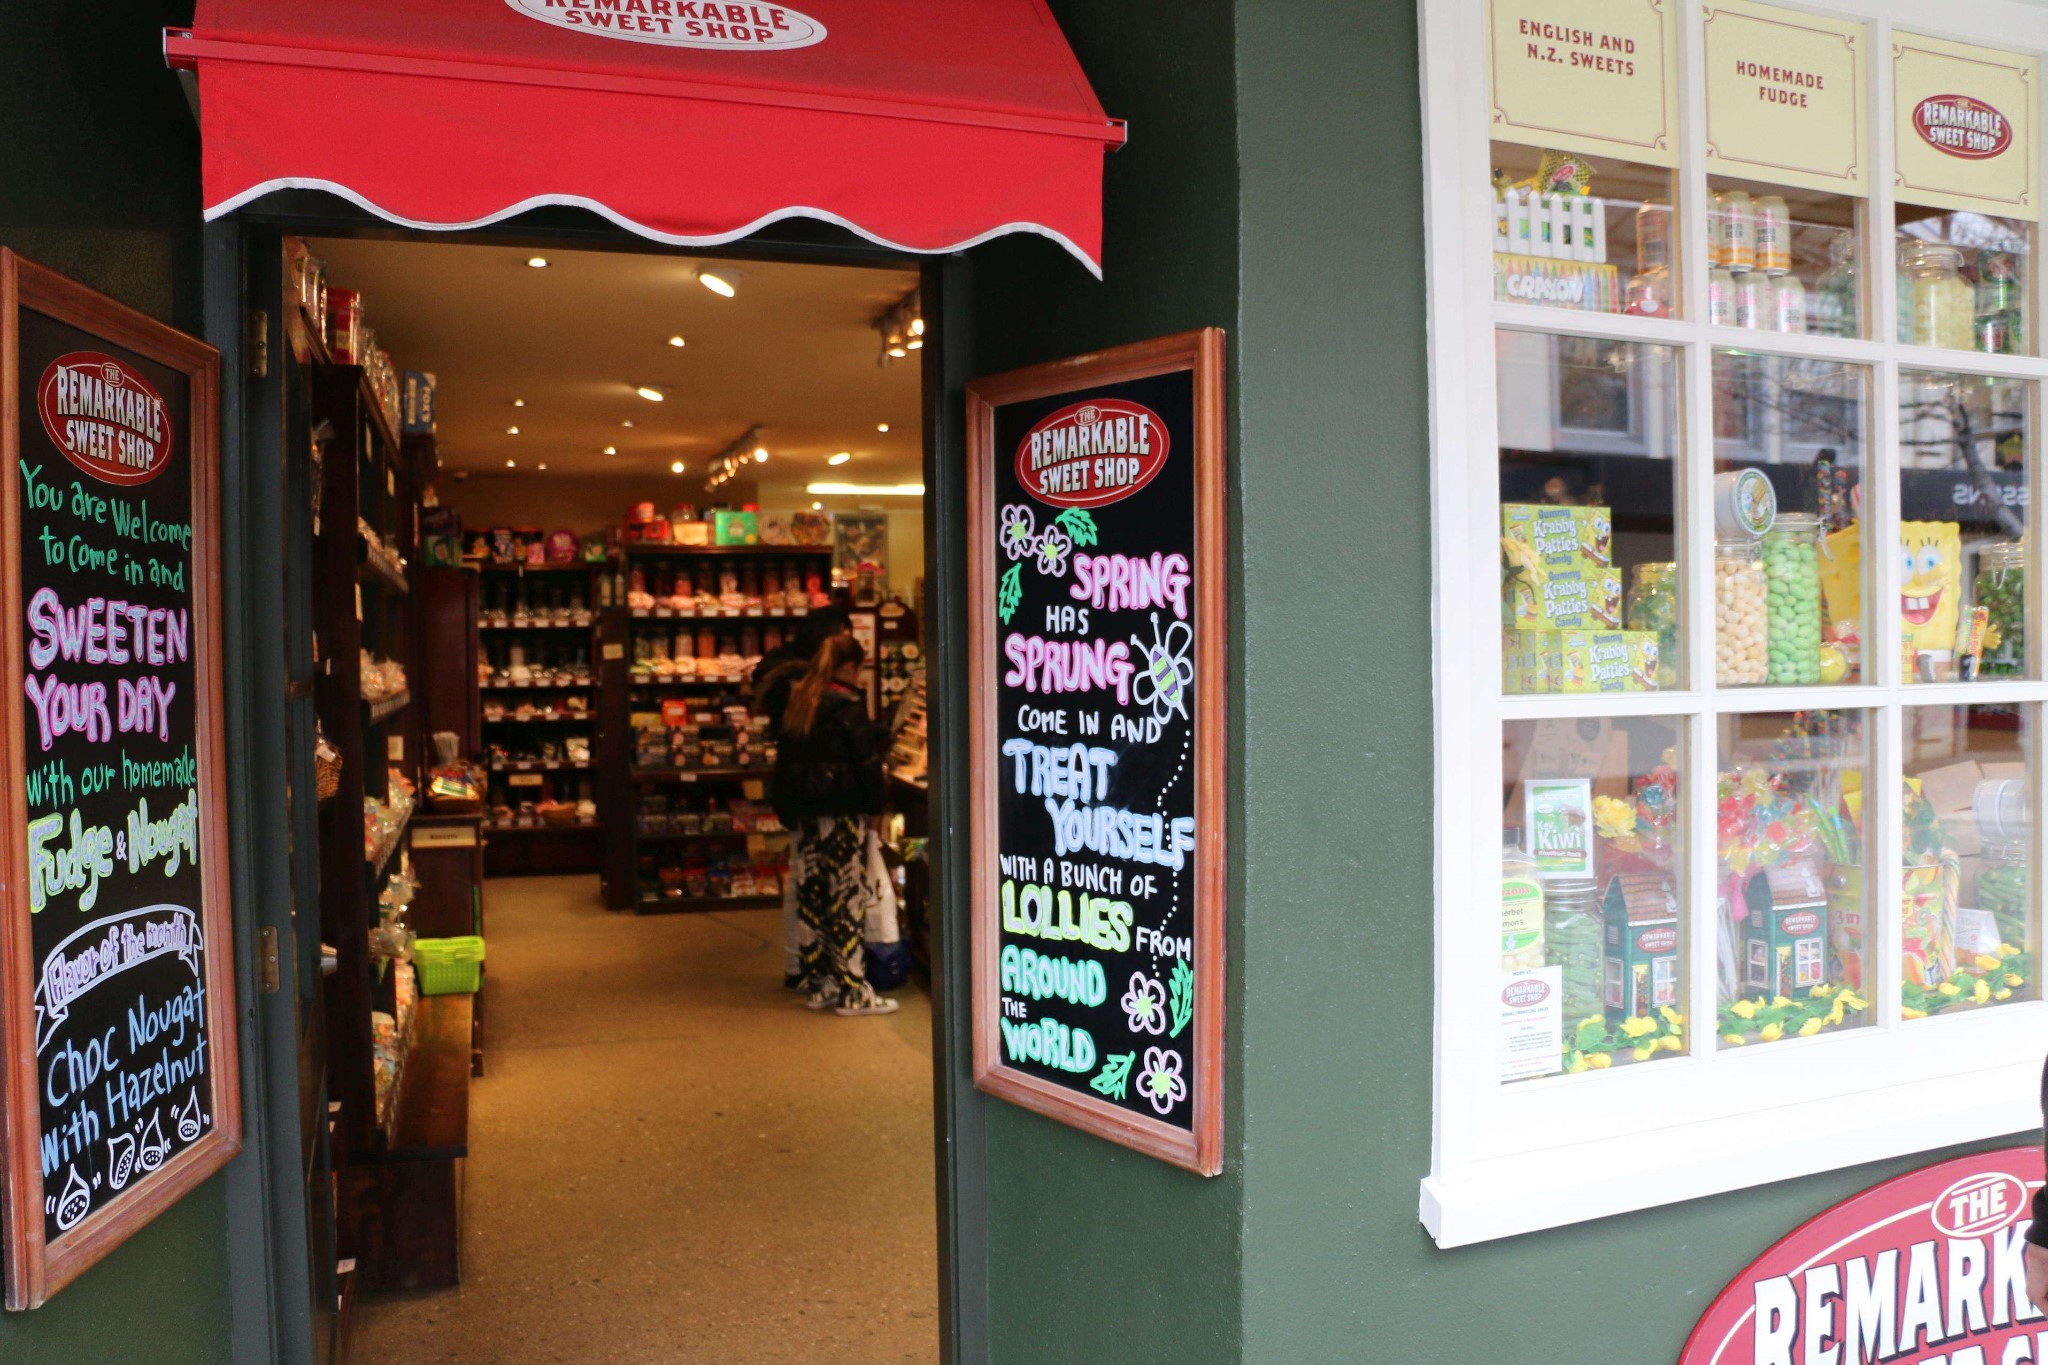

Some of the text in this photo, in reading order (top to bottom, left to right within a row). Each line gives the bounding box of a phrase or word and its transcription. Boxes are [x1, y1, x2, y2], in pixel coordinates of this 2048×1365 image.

[565, 10, 774, 43] SWEET SHOP
[1519, 19, 1635, 55] ENGLISH AND
[1527, 43, 1634, 76] N.Z. SWEETS
[1736, 60, 1824, 90] HOMEMADE
[1759, 86, 1808, 108] FUDGE
[1923, 102, 2002, 138] REMARKABLE
[1928, 126, 1997, 152] SWEET SHOP
[1506, 271, 1585, 304] CRAYON
[105, 365, 120, 382] THE
[57, 365, 162, 444] REMARKABLE
[1078, 409, 1096, 423] THE
[66, 419, 154, 471] SWEET SHOP
[1030, 413, 1150, 472] REMARKABLE
[1039, 457, 1141, 496] SWEET SHOP
[20, 458, 192, 551] You are Welcome
[1533, 518, 1577, 538] Krabby
[1535, 537, 1579, 556] Patties
[39, 525, 64, 566] to
[124, 553, 144, 586] in
[148, 557, 186, 593] and
[1069, 552, 1191, 620] SPRING
[1543, 580, 1588, 600] Krabby
[27, 586, 188, 670] SWEETEN
[1045, 605, 1089, 636] HAS
[1545, 599, 1588, 618] Patties
[1004, 632, 1136, 706] SPRUNG
[1589, 644, 1629, 664] Krabby
[1591, 662, 1630, 683] Patties
[24, 673, 176, 751] YOUR DAY
[1017, 704, 1161, 744] COME IN AND
[26, 744, 197, 810] with our homemade
[1002, 737, 1119, 804] TREAT
[28, 788, 198, 913] Fudge & Nougat
[1044, 797, 1195, 871] YOURSELF
[1538, 827, 1582, 850] Kiwi
[1000, 853, 1158, 899] WITH A BUNCH OF
[1001, 879, 1191, 961] LOLLIES FROM
[1502, 908, 1524, 917] erbet
[1502, 919, 1524, 927] mons
[100, 925, 120, 973] of
[120, 922, 146, 963] the
[145, 912, 187, 949] month
[1000, 944, 1107, 1008] AROUND
[1505, 983, 1546, 998] REMARKABLE
[128, 978, 206, 1055] Nougat
[1001, 997, 1027, 1018] THE
[1000, 1016, 1097, 1073] WORLD
[105, 1032, 207, 1129] Hazelnut
[1950, 1181, 2008, 1229] THE
